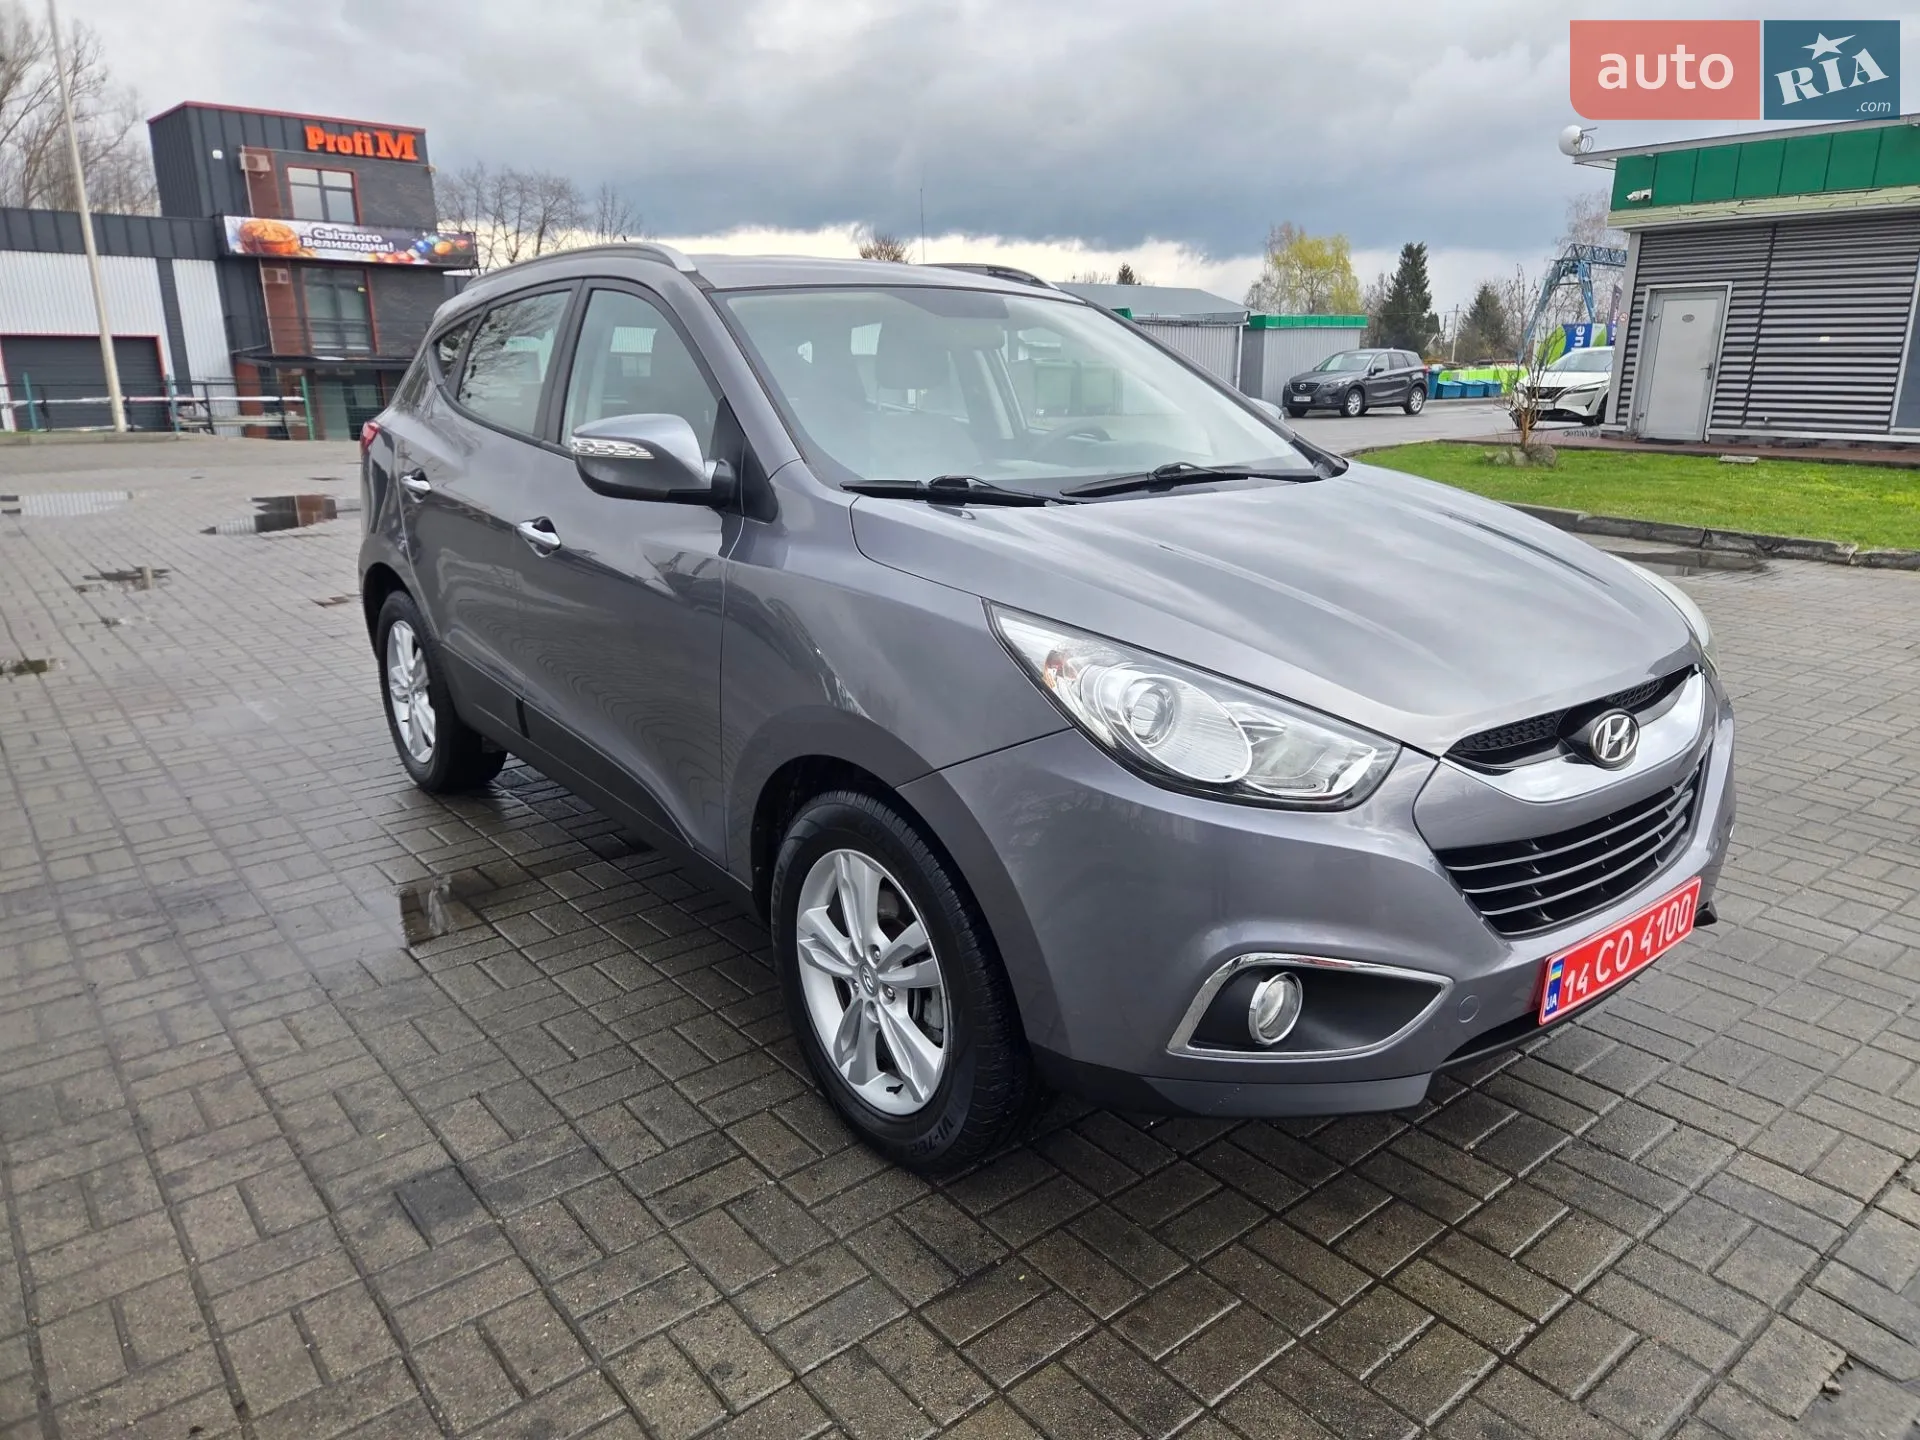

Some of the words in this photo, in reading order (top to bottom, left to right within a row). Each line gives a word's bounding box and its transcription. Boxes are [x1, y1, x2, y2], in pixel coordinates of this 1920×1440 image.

[304, 124, 374, 156] Profi
[374, 129, 419, 161] M
[312, 228, 383, 243] Світлого
[302, 237, 395, 252] Великодня!
[1565, 962, 1590, 1003] 14
[1595, 930, 1634, 983] CO
[1640, 893, 1692, 957] 4100
[1546, 993, 1557, 1010] UA
